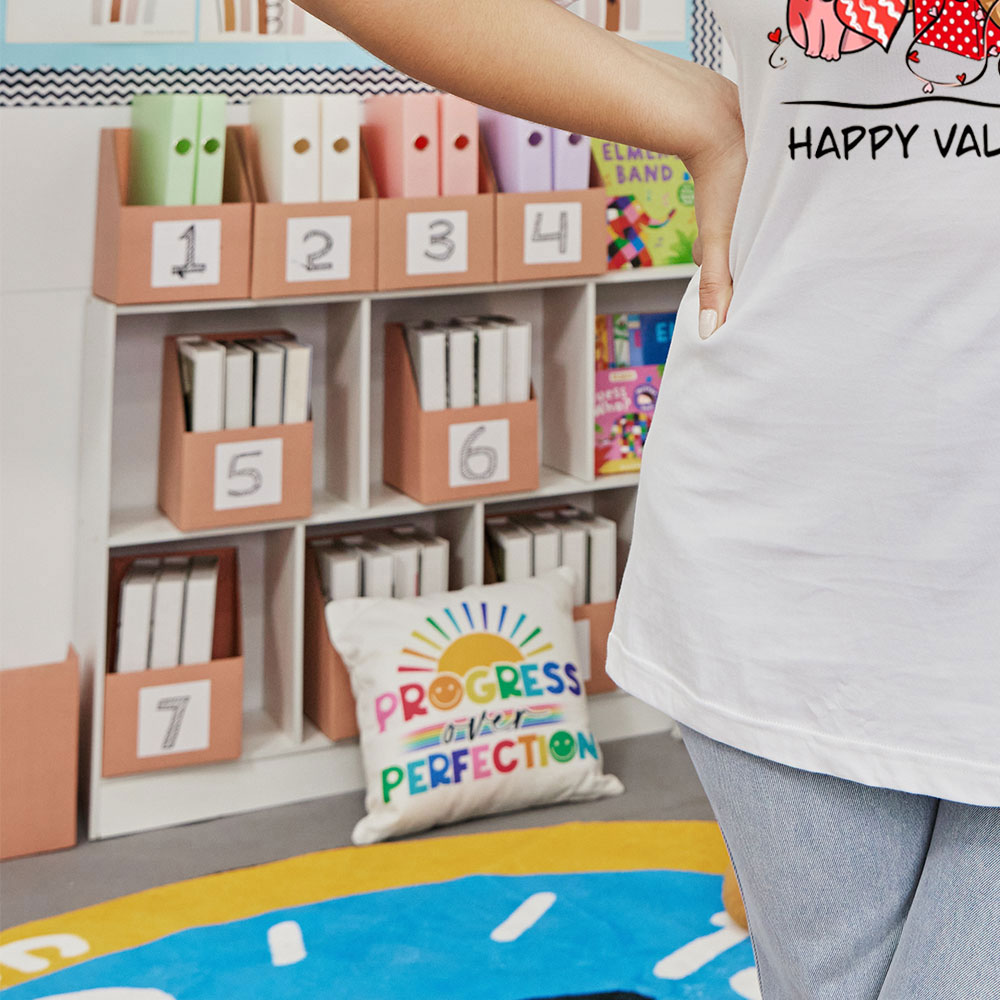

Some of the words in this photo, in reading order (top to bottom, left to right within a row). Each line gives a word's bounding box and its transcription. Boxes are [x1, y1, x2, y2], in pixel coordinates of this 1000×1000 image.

[787, 122, 921, 161] HAPPY
[615, 164, 674, 185] BAND
[171, 224, 207, 279] 1
[301, 229, 335, 271] 2
[424, 219, 456, 262] 3
[531, 211, 568, 255] 4
[226, 449, 263, 498] 5
[459, 425, 499, 482] 6
[374, 661, 582, 734] PROGRESS
[156, 693, 192, 750] 7
[443, 708, 527, 745] over
[381, 730, 600, 804] PERFECTION
